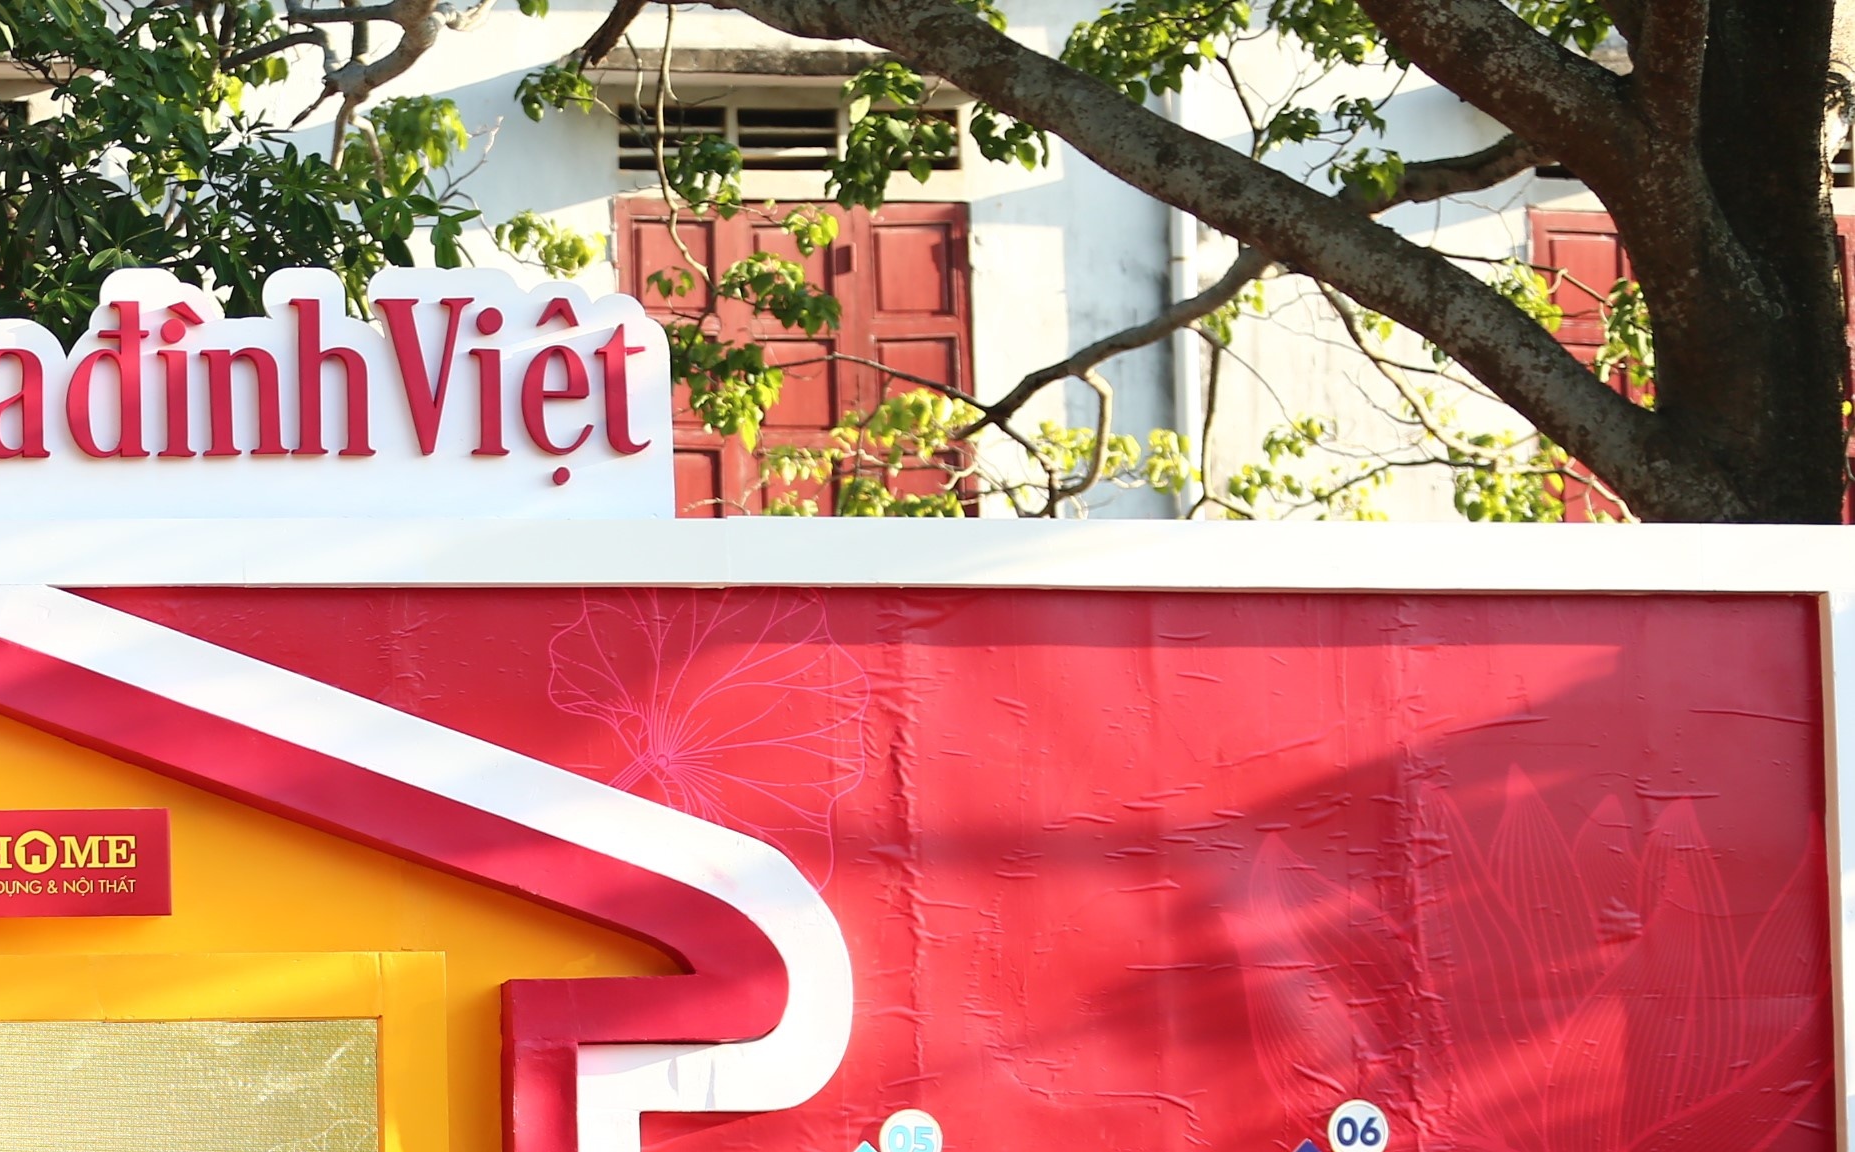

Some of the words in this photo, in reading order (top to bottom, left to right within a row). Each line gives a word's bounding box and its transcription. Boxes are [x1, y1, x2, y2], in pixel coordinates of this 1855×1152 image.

[65, 298, 376, 458] đình
[375, 297, 651, 486] Việt
[46, 880, 59, 894] &
[63, 876, 94, 897] NỘI
[98, 874, 137, 894] THẤT
[1336, 1116, 1383, 1147] 06
